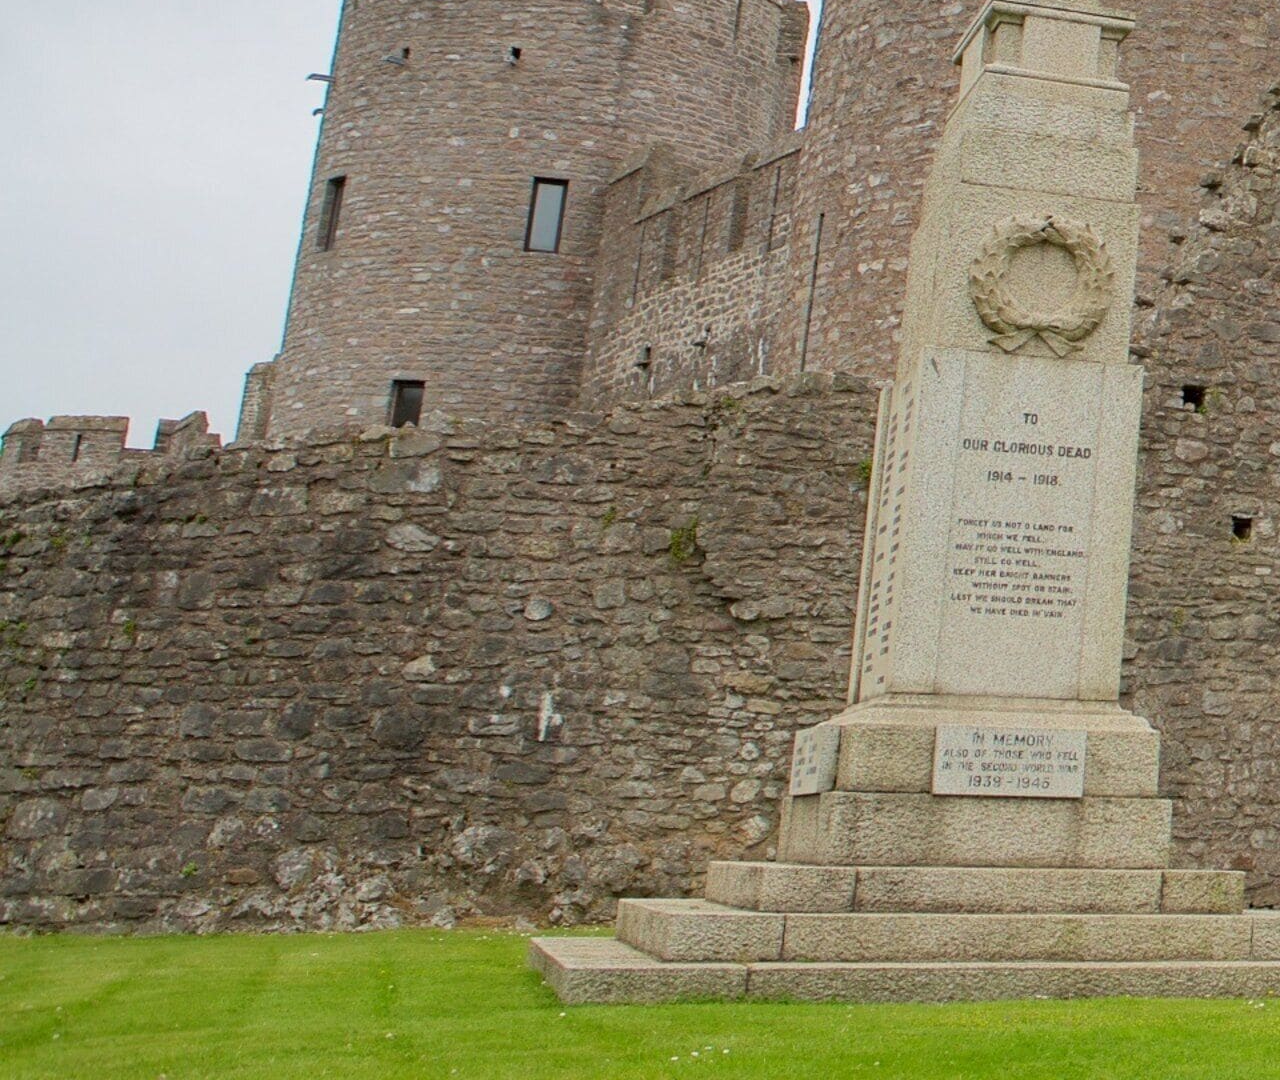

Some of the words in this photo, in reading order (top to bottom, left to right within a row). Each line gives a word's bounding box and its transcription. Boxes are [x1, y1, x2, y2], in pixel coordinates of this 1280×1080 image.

[1023, 413, 1038, 425] TO
[963, 438, 988, 451] OUR
[994, 440, 1054, 456] GLORIOUS
[1058, 445, 1092, 459] DEAD
[988, 470, 1013, 483] 1914
[1005, 521, 1022, 529] NOT
[1033, 523, 1055, 532] LAND
[1058, 525, 1074, 533] FOR
[955, 543, 973, 551] MAY
[1000, 546, 1021, 554] WELL
[978, 568, 996, 576] HER
[951, 593, 971, 601] LEST
[970, 606, 982, 614] WE
[985, 607, 1006, 615] HAVE
[972, 732, 984, 744] IN
[993, 734, 1054, 746] MEMORY
[943, 749, 968, 758] ALSO
[974, 749, 987, 758] OF
[993, 750, 1024, 759] THOSE
[1030, 750, 1052, 759] WHO
[1057, 751, 1078, 761] FELL
[981, 762, 1017, 772] SECOND
[1023, 764, 1053, 773] WORLD
